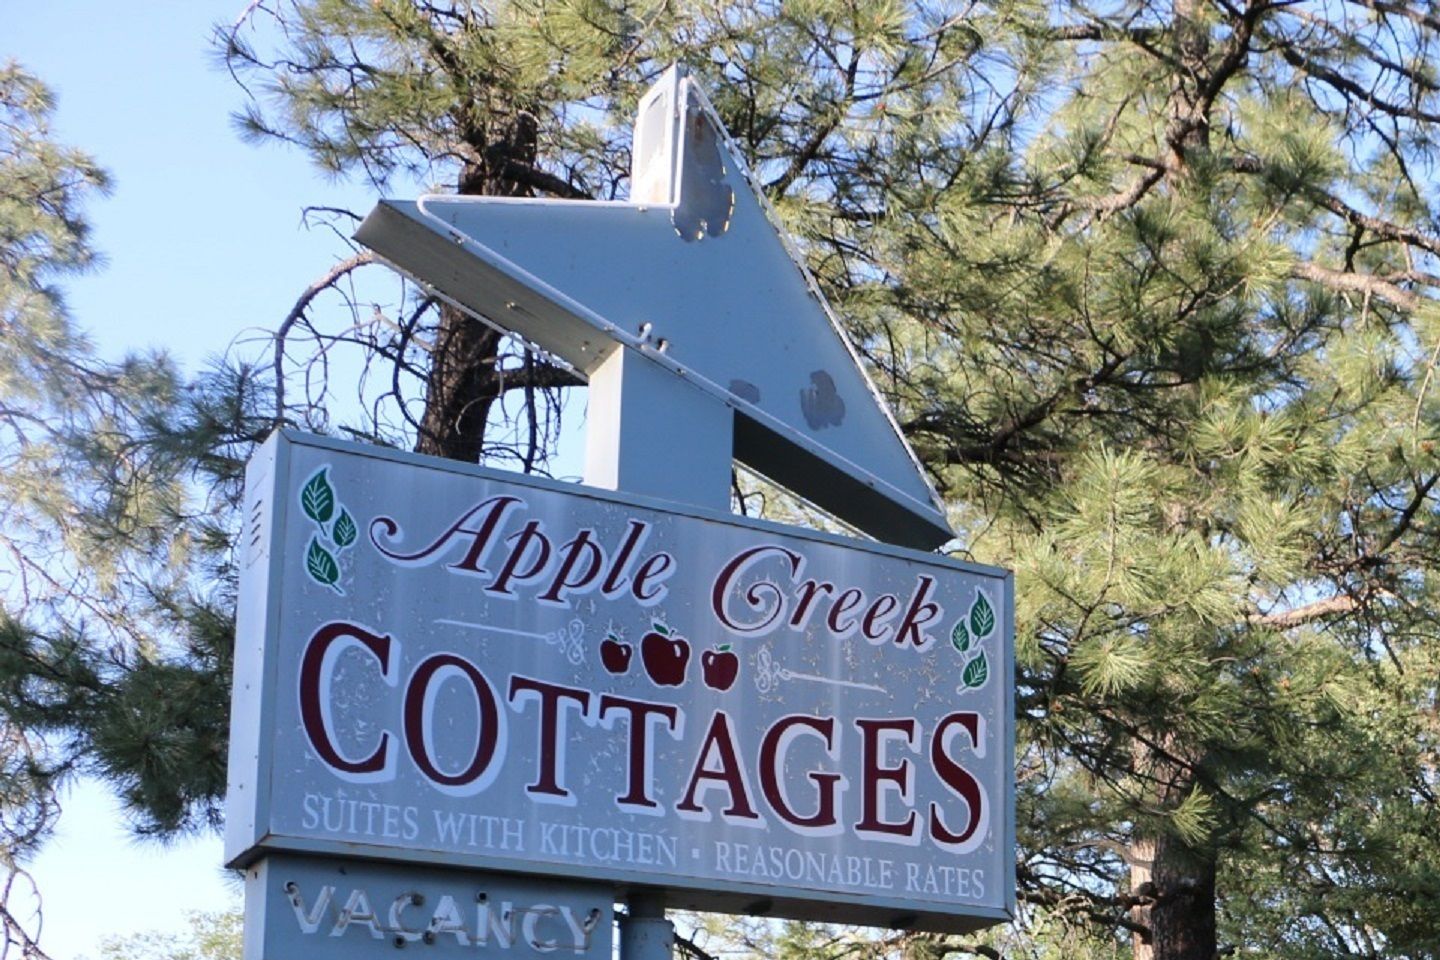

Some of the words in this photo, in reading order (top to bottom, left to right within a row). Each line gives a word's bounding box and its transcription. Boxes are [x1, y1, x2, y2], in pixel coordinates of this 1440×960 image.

[368, 495, 674, 604] Apple
[711, 545, 941, 649] Creek
[299, 620, 986, 848] COTTAGES
[301, 795, 419, 841] SUITES
[433, 809, 525, 852] WITH
[539, 822, 679, 867] KITCHEN
[715, 840, 894, 889] REASONABLE
[904, 861, 985, 899] RATES
[286, 882, 600, 955] VACANCY
